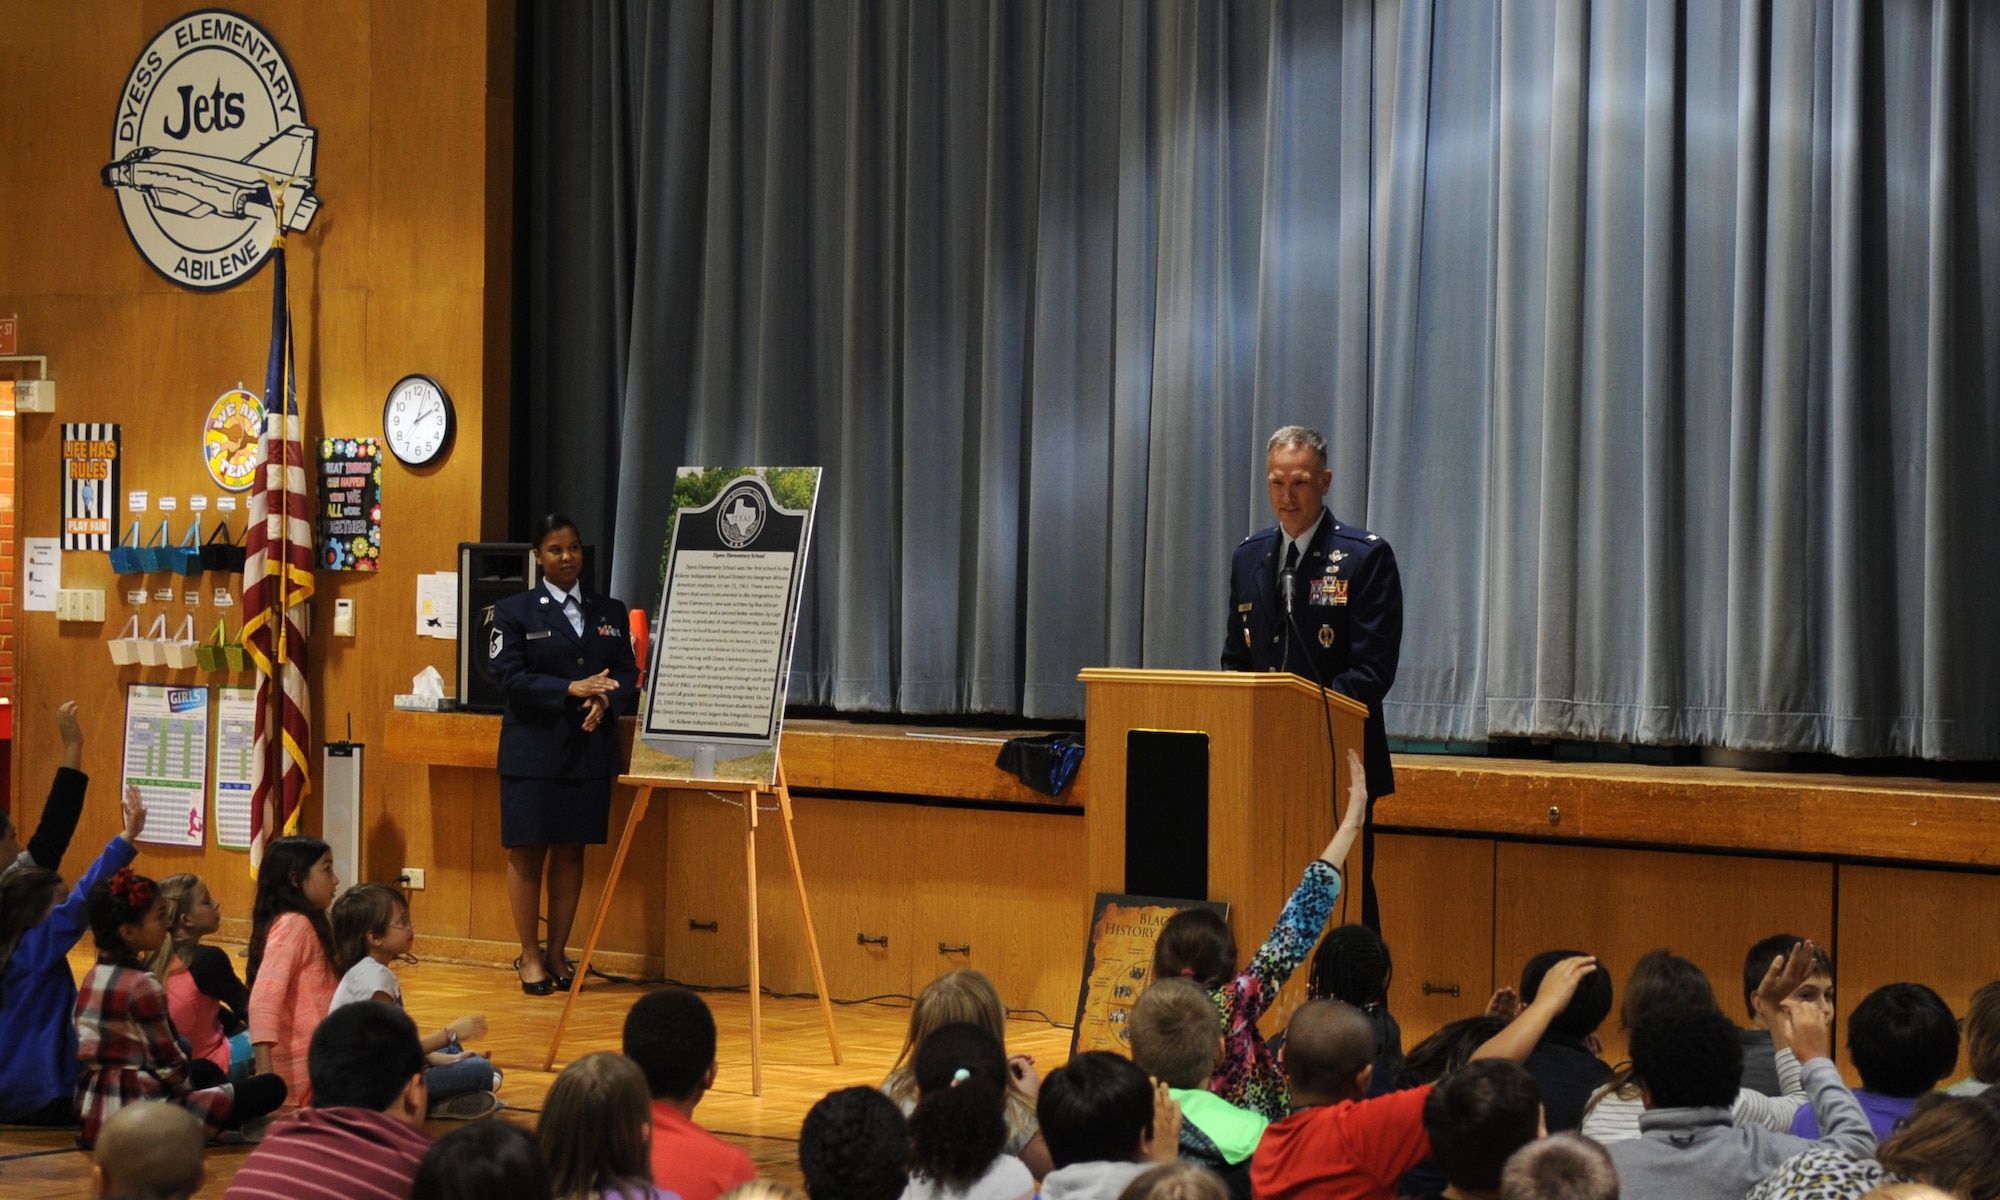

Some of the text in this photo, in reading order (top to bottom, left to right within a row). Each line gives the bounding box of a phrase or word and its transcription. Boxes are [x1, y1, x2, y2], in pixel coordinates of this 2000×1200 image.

[119, 18, 297, 142] DYESS ELEMENTARY
[163, 77, 246, 140] Jets
[173, 238, 260, 281] ABILENE
[404, 390, 411, 400] 11
[414, 385, 423, 396] 12
[427, 390, 431, 400] 1
[396, 401, 406, 412] 10
[434, 401, 440, 412] 2
[213, 402, 236, 428] WE
[437, 415, 443, 426] 3
[393, 416, 400, 426] 9
[396, 431, 403, 441] 8
[433, 431, 440, 440] 4
[63, 440, 116, 460] LIFE HAS
[210, 440, 221, 457] A
[404, 441, 410, 452] 7
[415, 446, 421, 456] 6
[426, 441, 432, 452] 5
[70, 461, 107, 480] RULES
[327, 503, 343, 518] ALL
[68, 521, 107, 532] PLAY FAIR
[170, 689, 201, 704] GIRLS
[1140, 912, 1169, 926] BLAC
[1105, 922, 1156, 938] HISTORY
